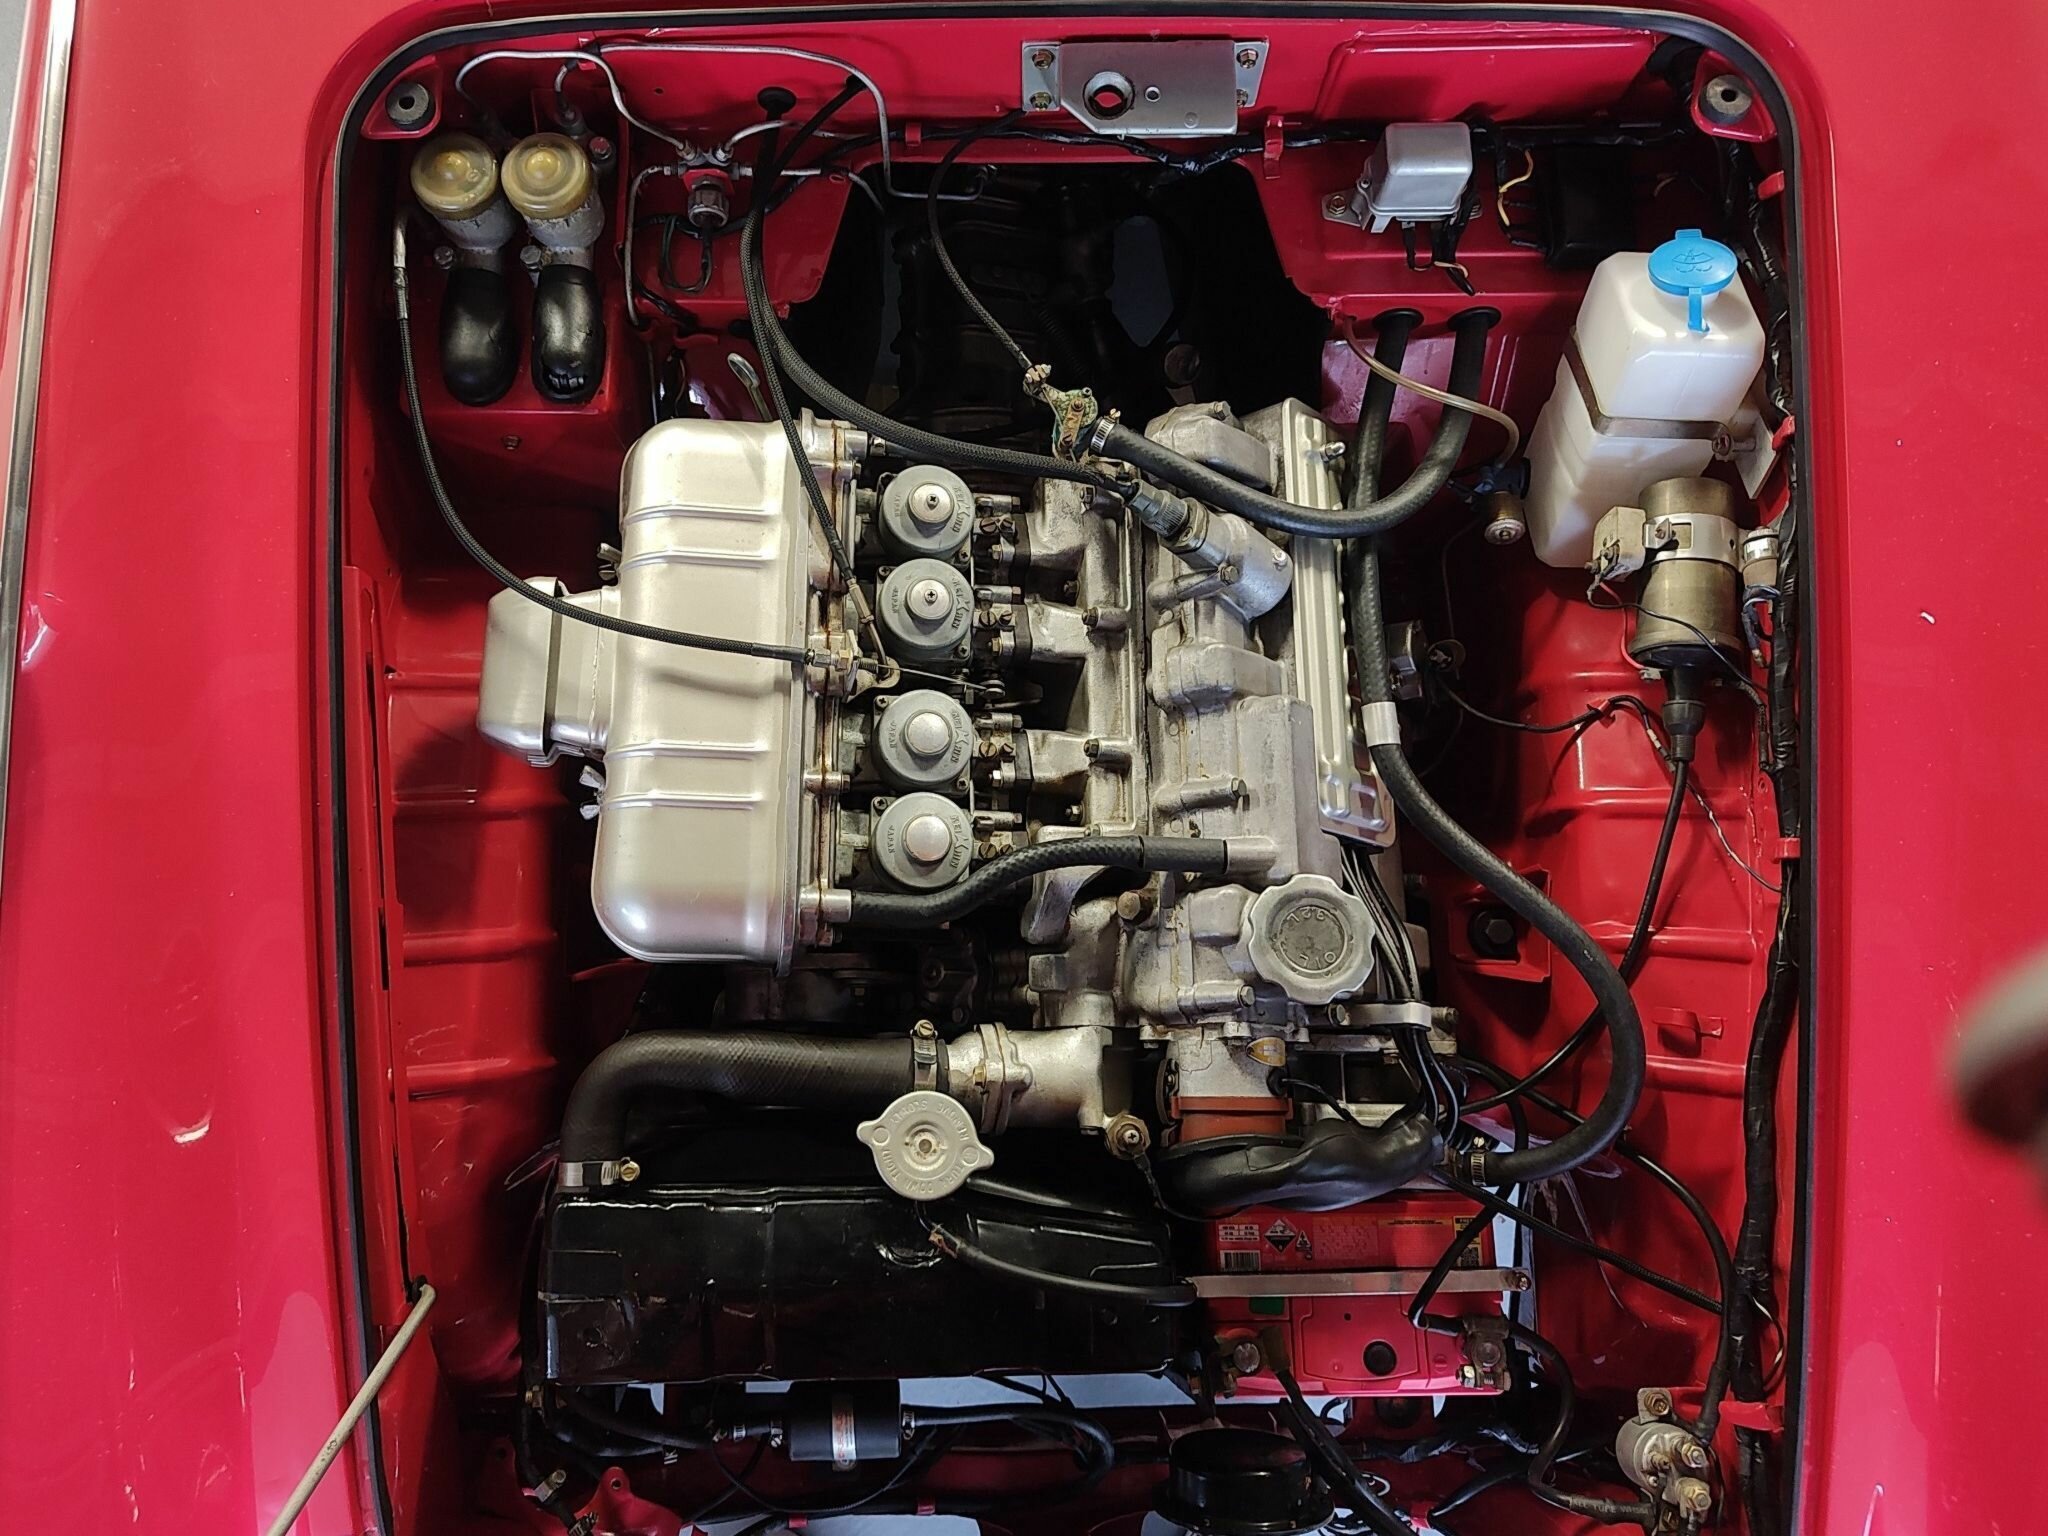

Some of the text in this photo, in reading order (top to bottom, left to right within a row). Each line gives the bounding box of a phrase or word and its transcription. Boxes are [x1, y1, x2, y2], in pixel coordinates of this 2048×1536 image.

[894, 494, 902, 518] JAPAN
[890, 585, 899, 614] JAPAN
[888, 721, 897, 748] JAPAN
[886, 825, 896, 853] JAPAN
[1300, 951, 1336, 969] OIL
[890, 1100, 969, 1141] REMOVE SLOWLY
